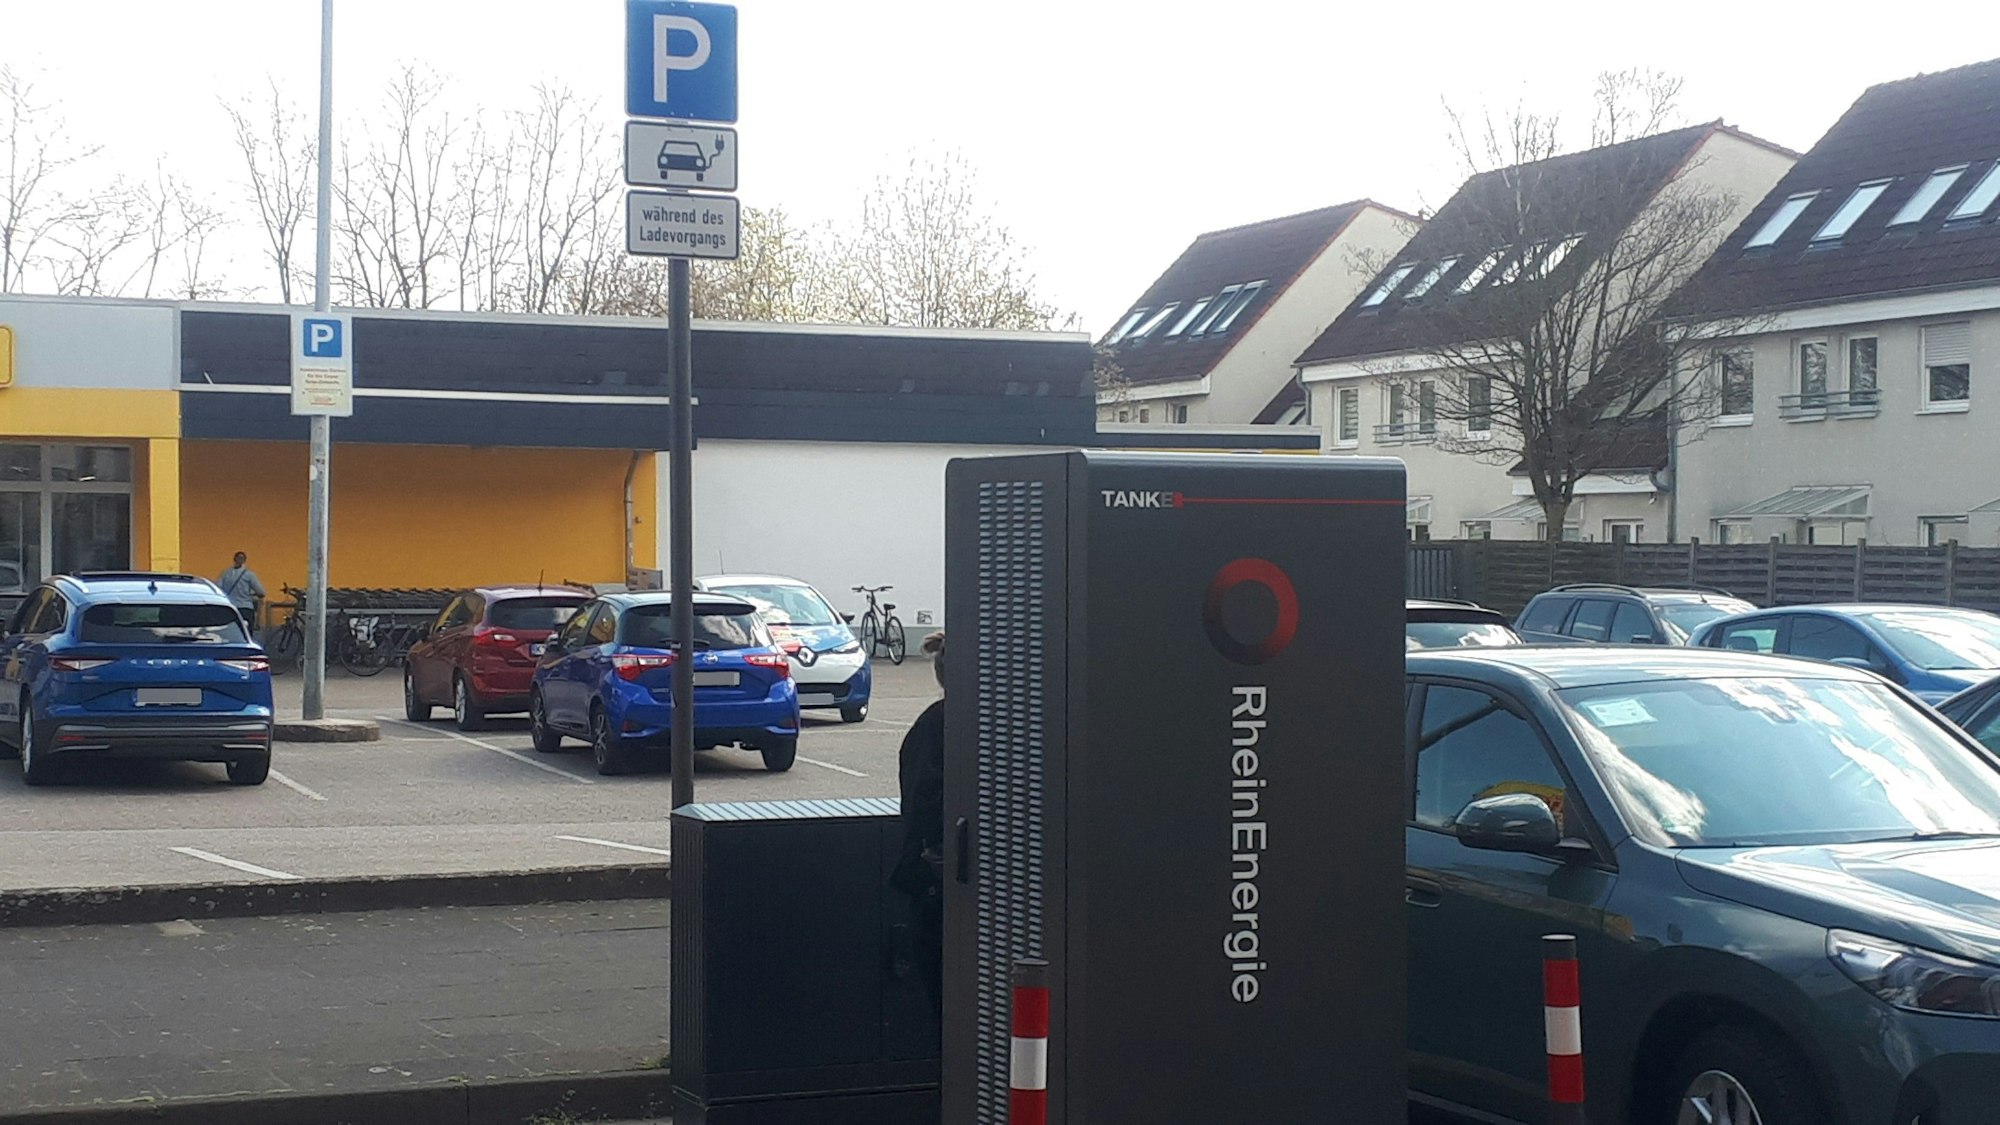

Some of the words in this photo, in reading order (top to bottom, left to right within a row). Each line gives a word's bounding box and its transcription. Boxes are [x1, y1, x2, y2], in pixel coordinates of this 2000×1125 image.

[653, 14, 711, 103] P
[643, 206, 696, 223] während
[702, 209, 724, 225] des
[640, 226, 726, 249] Ladevorgangs
[311, 324, 334, 353] P
[1223, 686, 1267, 1003] RheinEnergie
